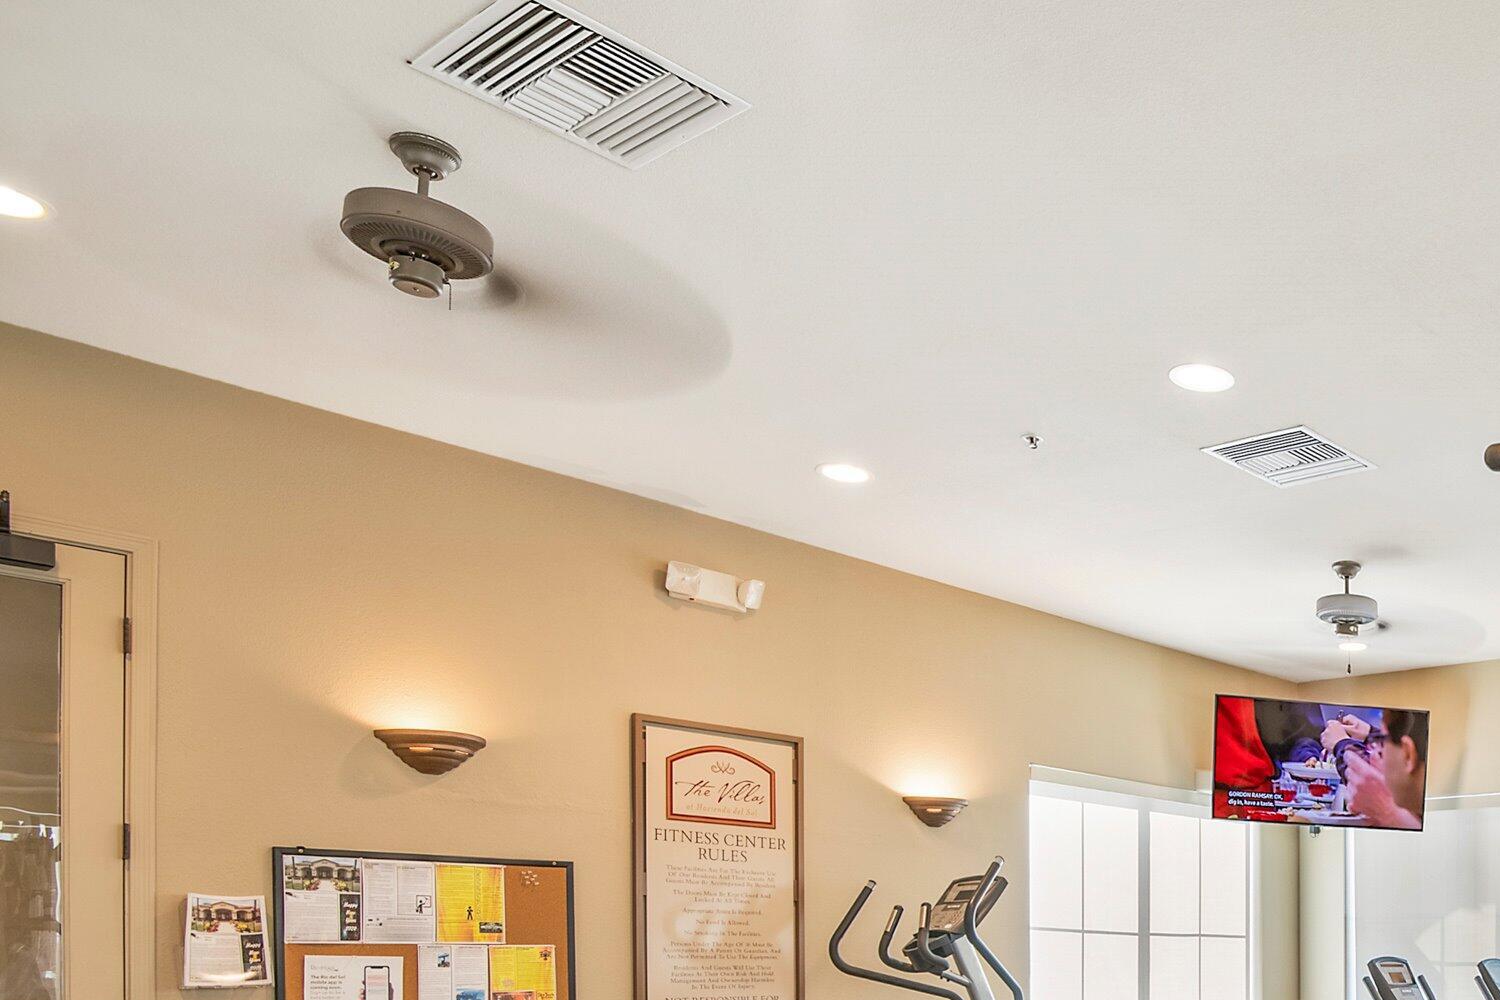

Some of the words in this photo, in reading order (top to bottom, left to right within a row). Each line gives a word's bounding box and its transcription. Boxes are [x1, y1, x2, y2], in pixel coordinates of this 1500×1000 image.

[674, 780, 716, 797] The
[717, 779, 765, 805] Villas
[654, 827, 720, 846] FITNESS
[723, 833, 787, 851] CENTER
[698, 847, 748, 863] RULES
